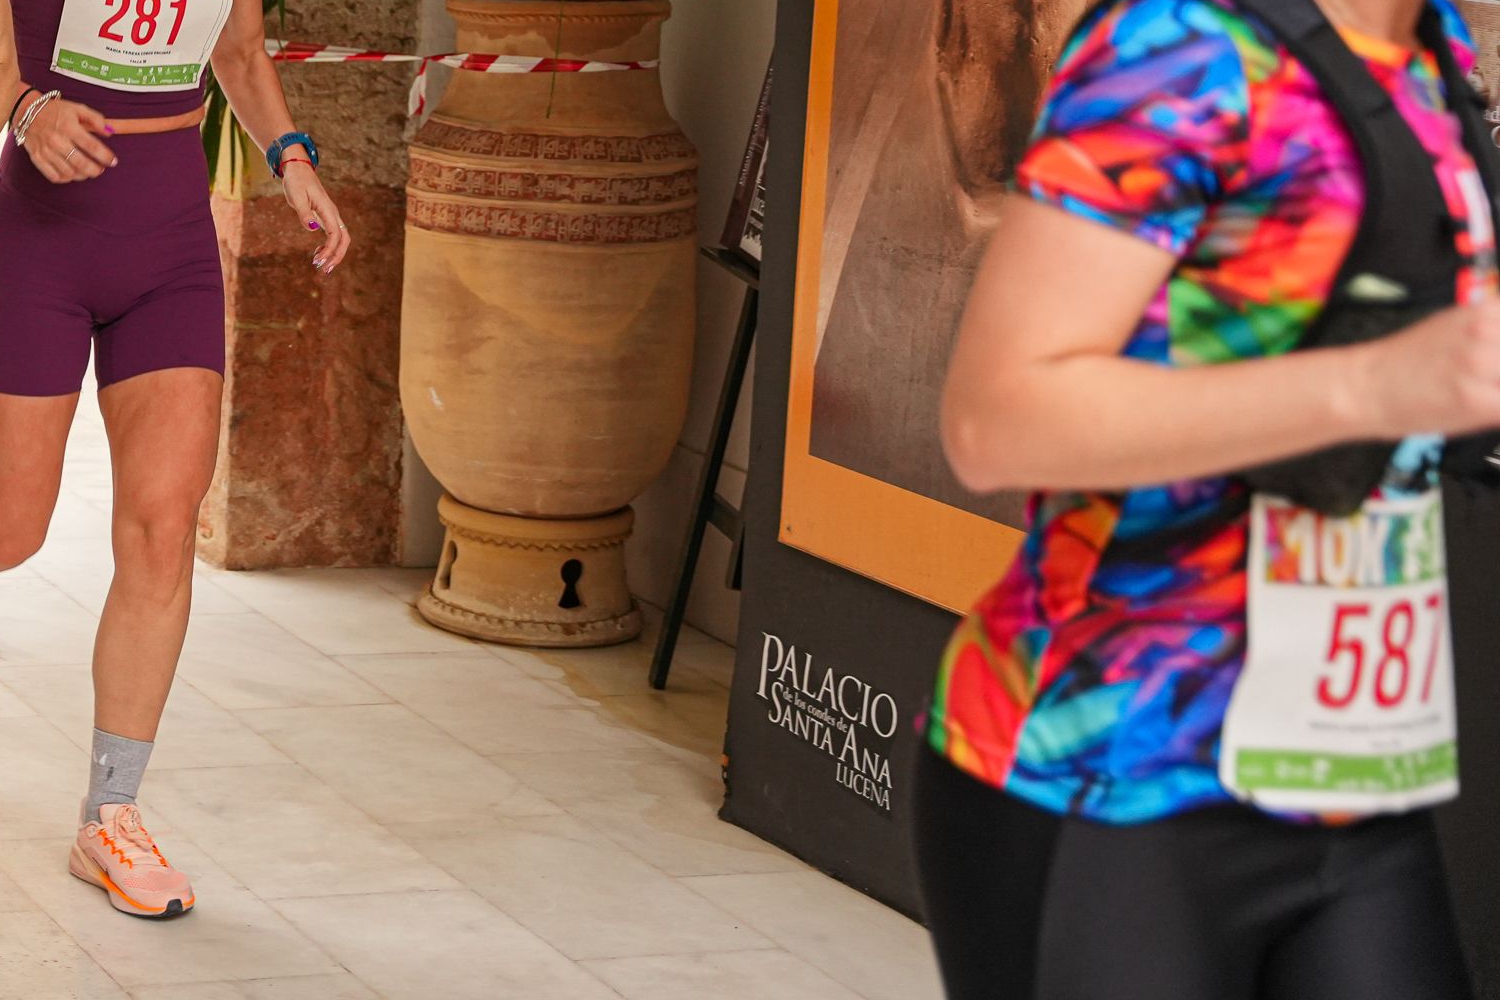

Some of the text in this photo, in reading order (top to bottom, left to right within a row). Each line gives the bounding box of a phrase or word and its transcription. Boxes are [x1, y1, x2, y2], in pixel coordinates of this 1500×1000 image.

[756, 631, 898, 738] PALACIO
[783, 687, 848, 733] de los condes de
[768, 681, 892, 789] SANTA ANA
[836, 762, 890, 811] LUCENA
